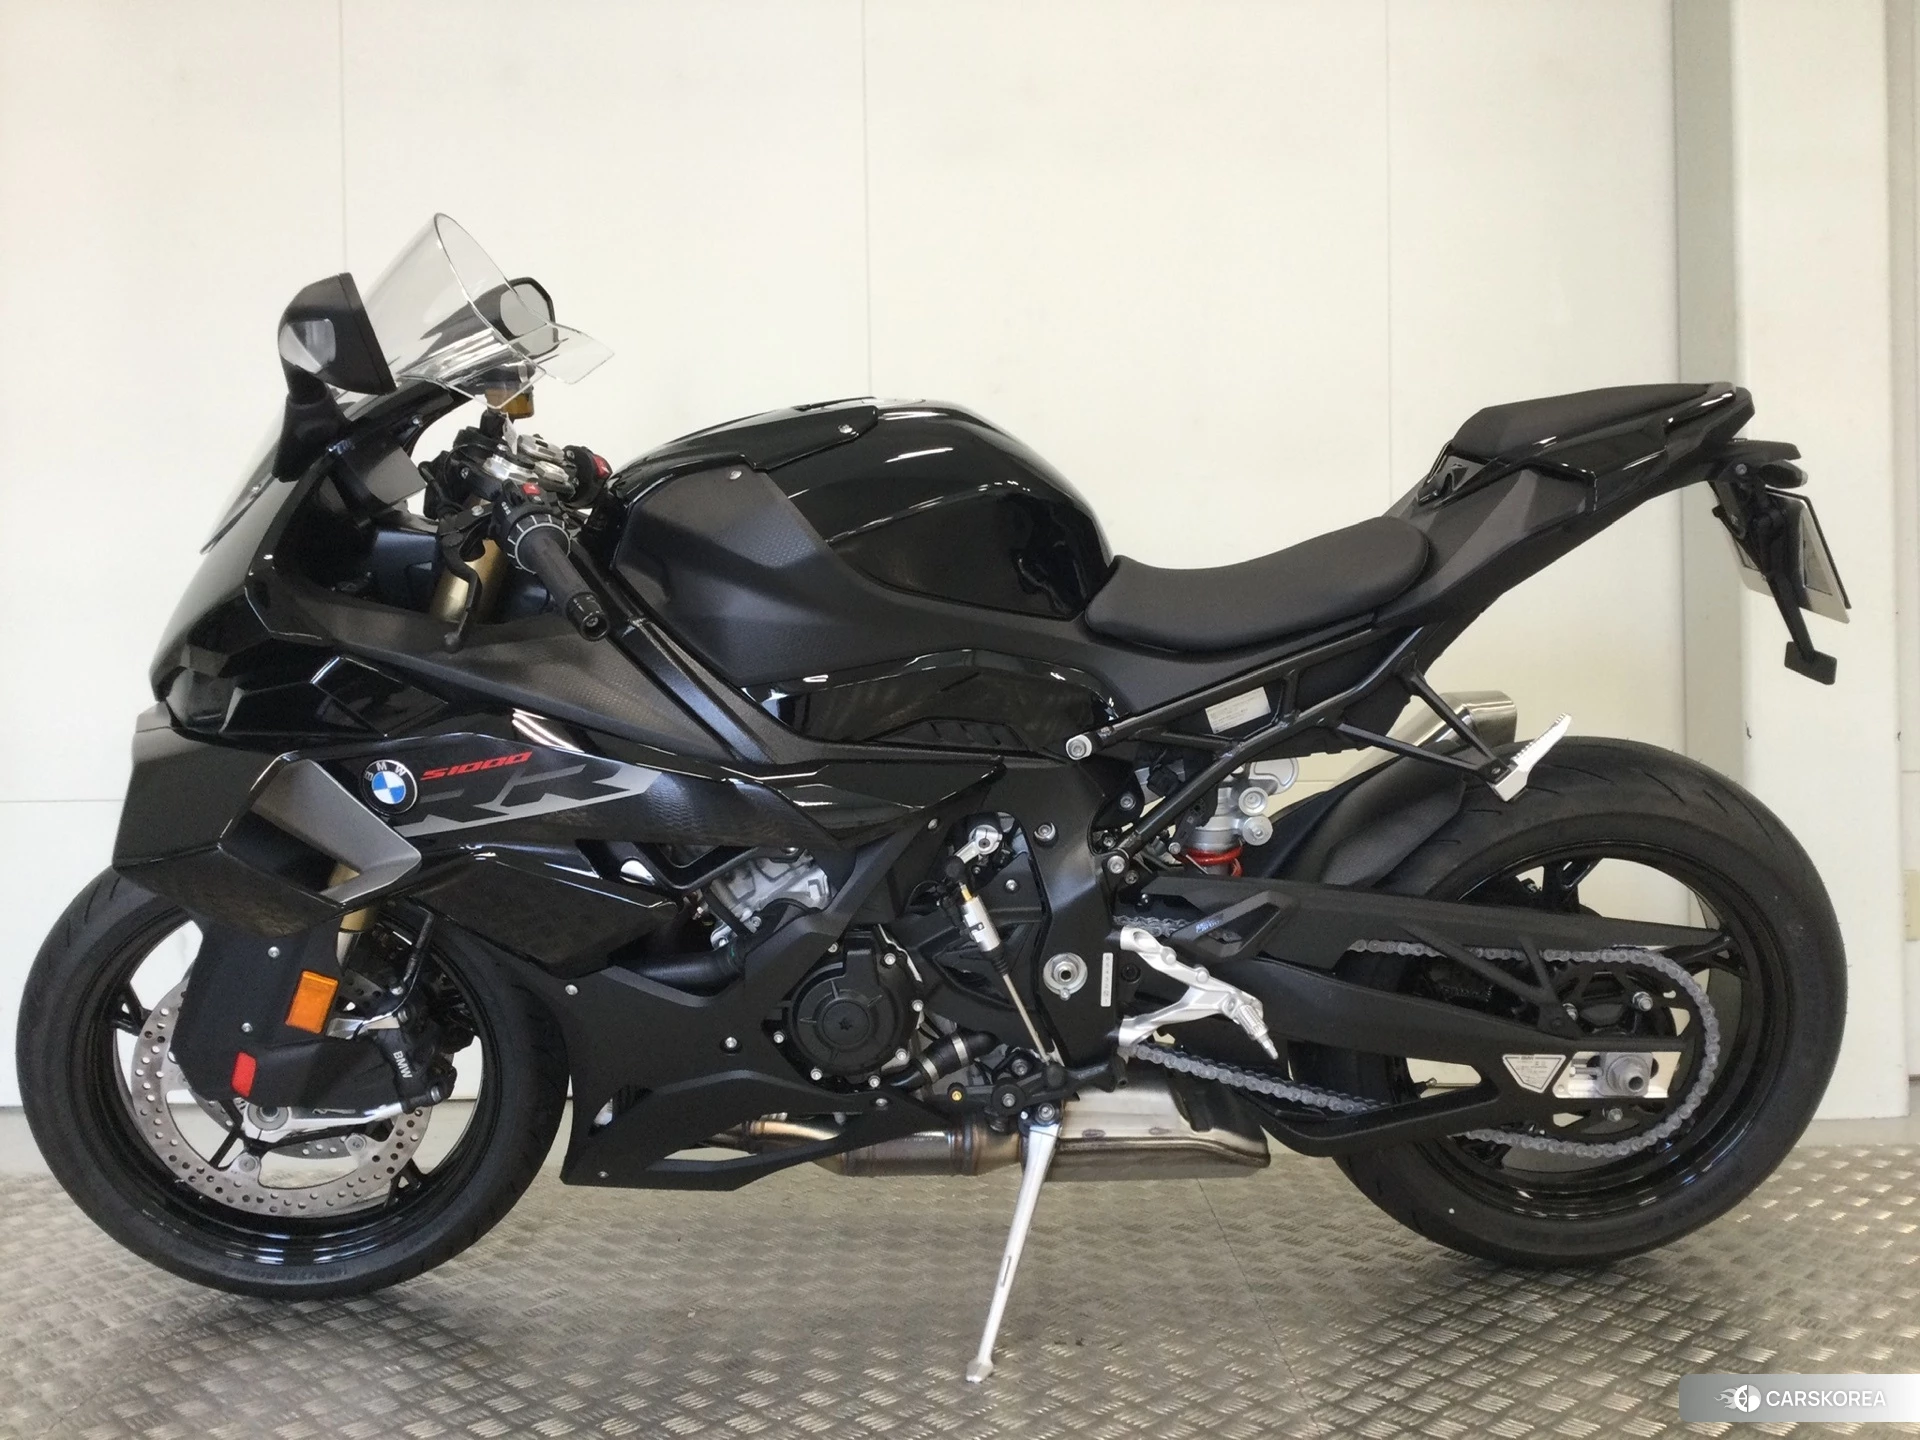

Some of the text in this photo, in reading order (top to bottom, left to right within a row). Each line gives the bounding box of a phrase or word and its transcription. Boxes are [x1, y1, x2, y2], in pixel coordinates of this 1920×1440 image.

[364, 761, 407, 782] BMW
[420, 751, 533, 781] S1000
[393, 1050, 413, 1078] BMW
